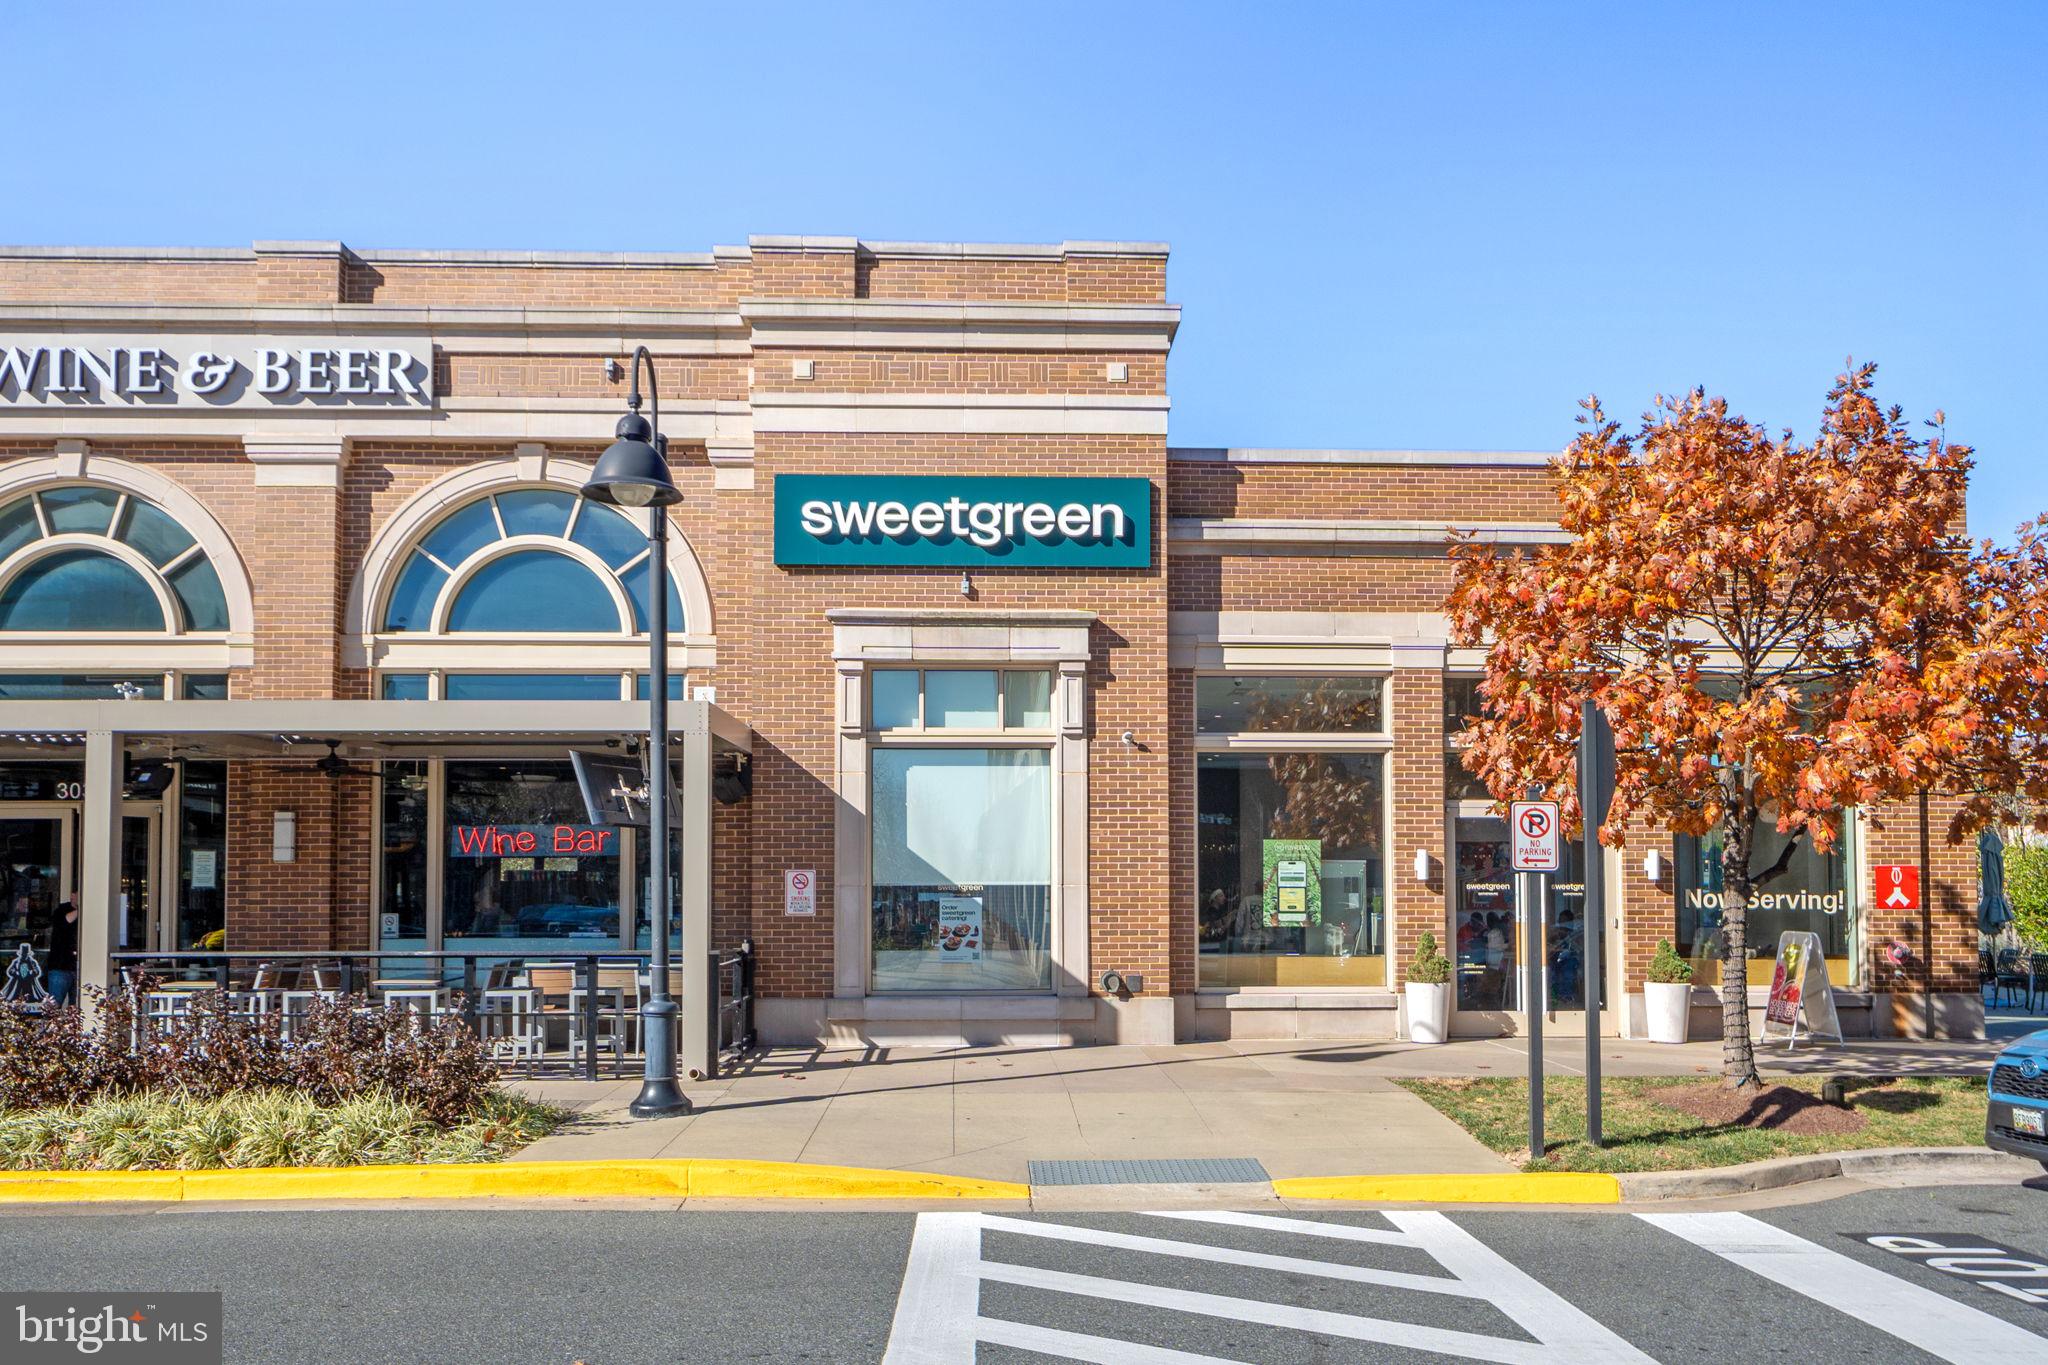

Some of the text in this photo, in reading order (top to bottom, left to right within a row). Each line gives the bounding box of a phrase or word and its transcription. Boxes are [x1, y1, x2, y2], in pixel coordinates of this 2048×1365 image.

[0, 346, 418, 395] WINE & BEER
[801, 497, 1125, 547] sweetgreen
[57, 782, 86, 799] 30
[458, 825, 612, 855] Wine Bar
[1529, 839, 1541, 848] NO
[1519, 847, 1552, 856] PARKING
[1466, 882, 1510, 892] sweetgreen
[1747, 889, 1844, 915] Serving!
